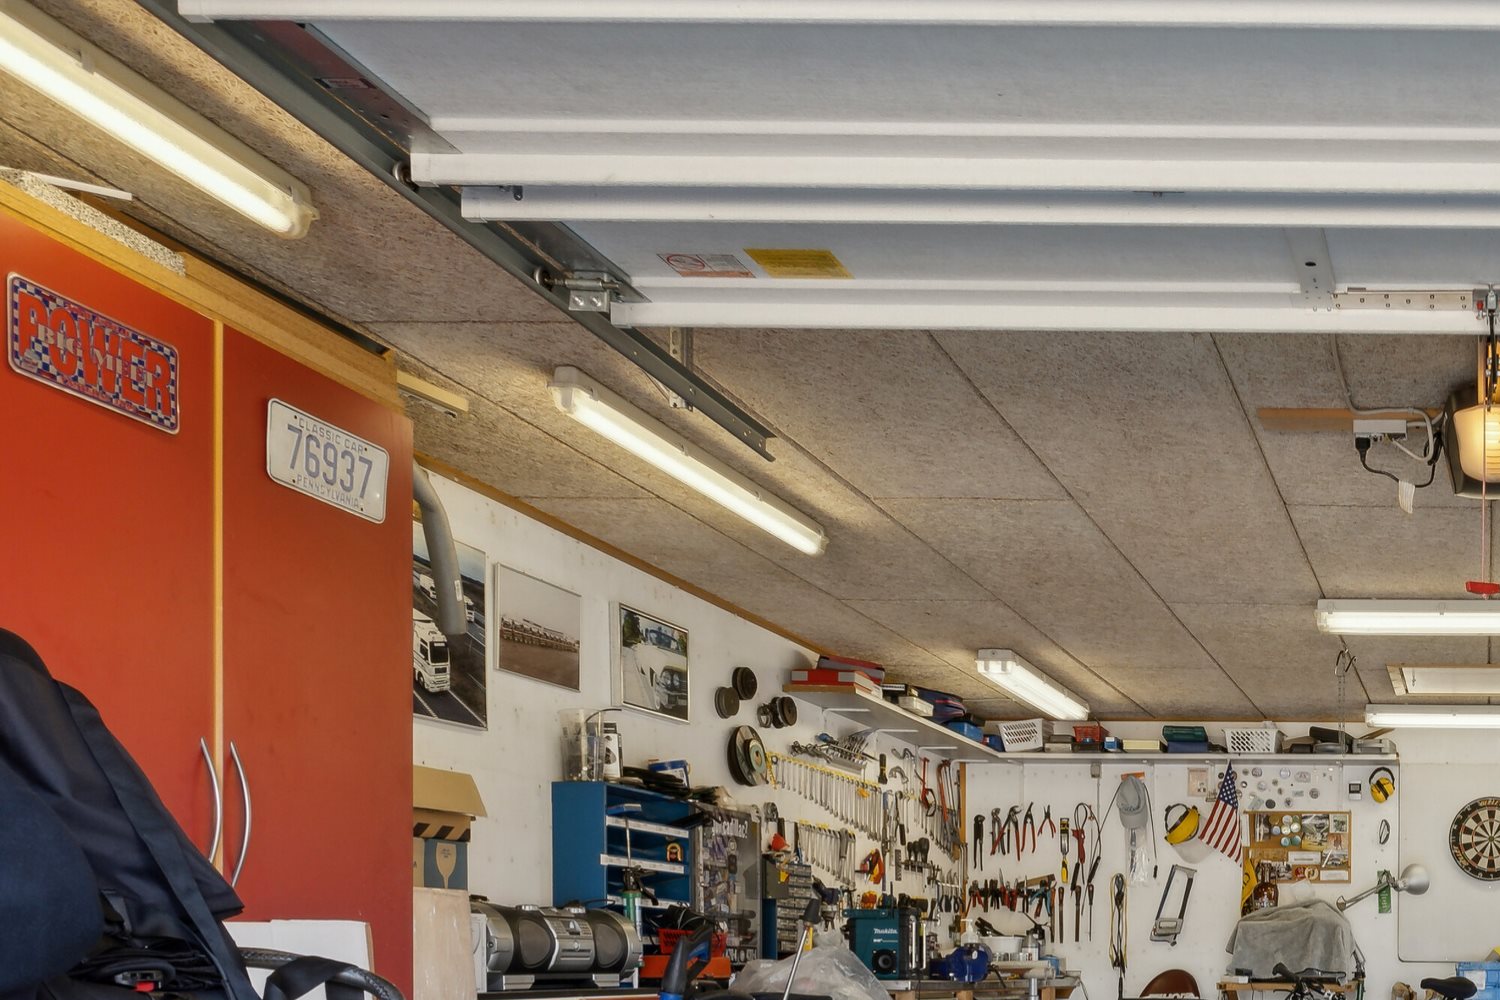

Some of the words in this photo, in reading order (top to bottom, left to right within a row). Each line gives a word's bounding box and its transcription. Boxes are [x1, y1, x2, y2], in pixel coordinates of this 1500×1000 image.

[18, 290, 172, 418] POWER
[287, 423, 373, 499] 76937
[299, 418, 341, 446] CLASSIC
[344, 438, 364, 455] CAR
[296, 474, 360, 508] PENNSYLVANIA
